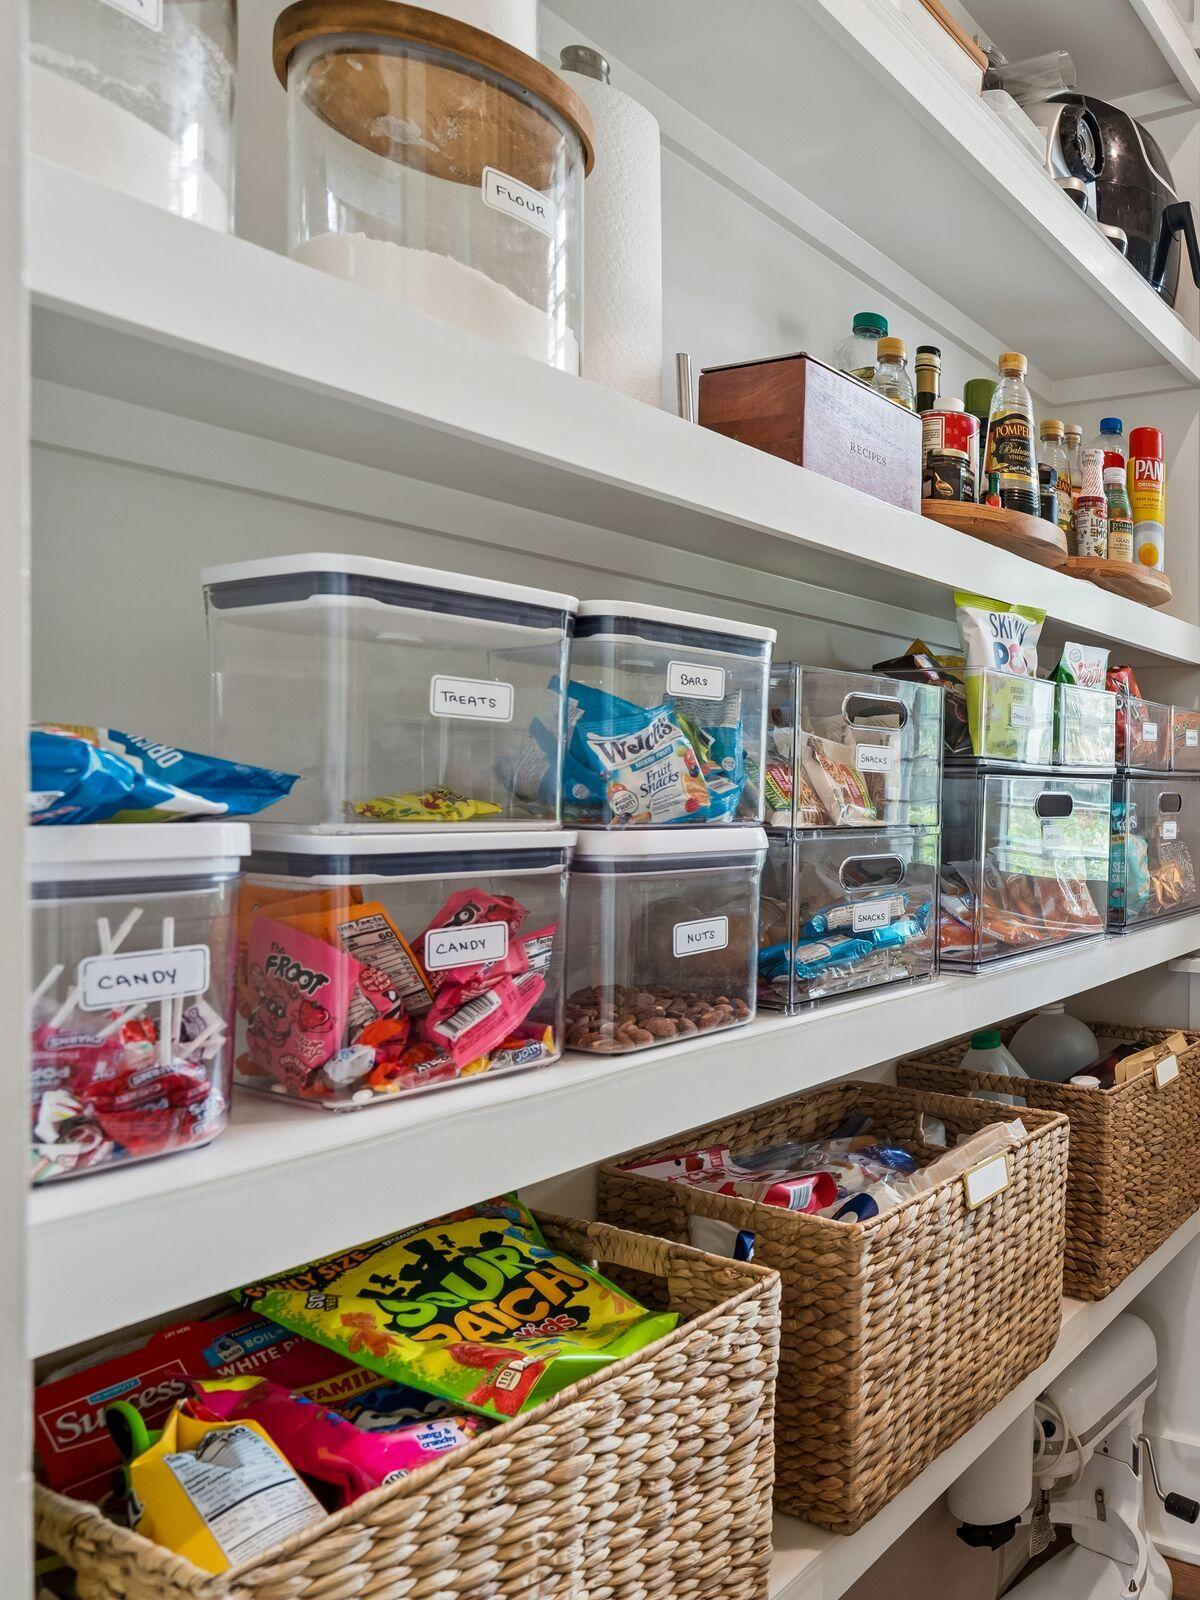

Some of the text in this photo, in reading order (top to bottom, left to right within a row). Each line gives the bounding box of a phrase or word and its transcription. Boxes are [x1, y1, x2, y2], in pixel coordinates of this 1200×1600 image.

[496, 185, 545, 218] FLOUR
[850, 441, 887, 467] RECIPES
[992, 641, 1028, 676] PO
[680, 673, 708, 687] BARS
[441, 690, 497, 709] TREATS
[594, 717, 673, 764] Welch's
[634, 754, 656, 769] MIXED
[655, 745, 673, 760] FRUIT
[861, 754, 888, 765] SNACKS
[639, 771, 679, 798] Snacks
[646, 762, 673, 784] Fruit
[857, 912, 886, 924] SNACKS
[435, 939, 486, 955] CANDY
[687, 929, 715, 945] NUTS
[97, 968, 178, 990] CANDY
[264, 954, 330, 996] FROOT
[396, 1246, 536, 1328] SOUR
[411, 1267, 586, 1344] PATCH
[513, 1313, 579, 1341] Kids
[217, 1346, 281, 1377] WHITE
[223, 1346, 243, 1361] BAGS
[303, 1366, 383, 1403] FAMIL
[56, 1379, 187, 1443] Suess
[416, 1427, 451, 1440] tangy &
[421, 1435, 457, 1449] crunchy
